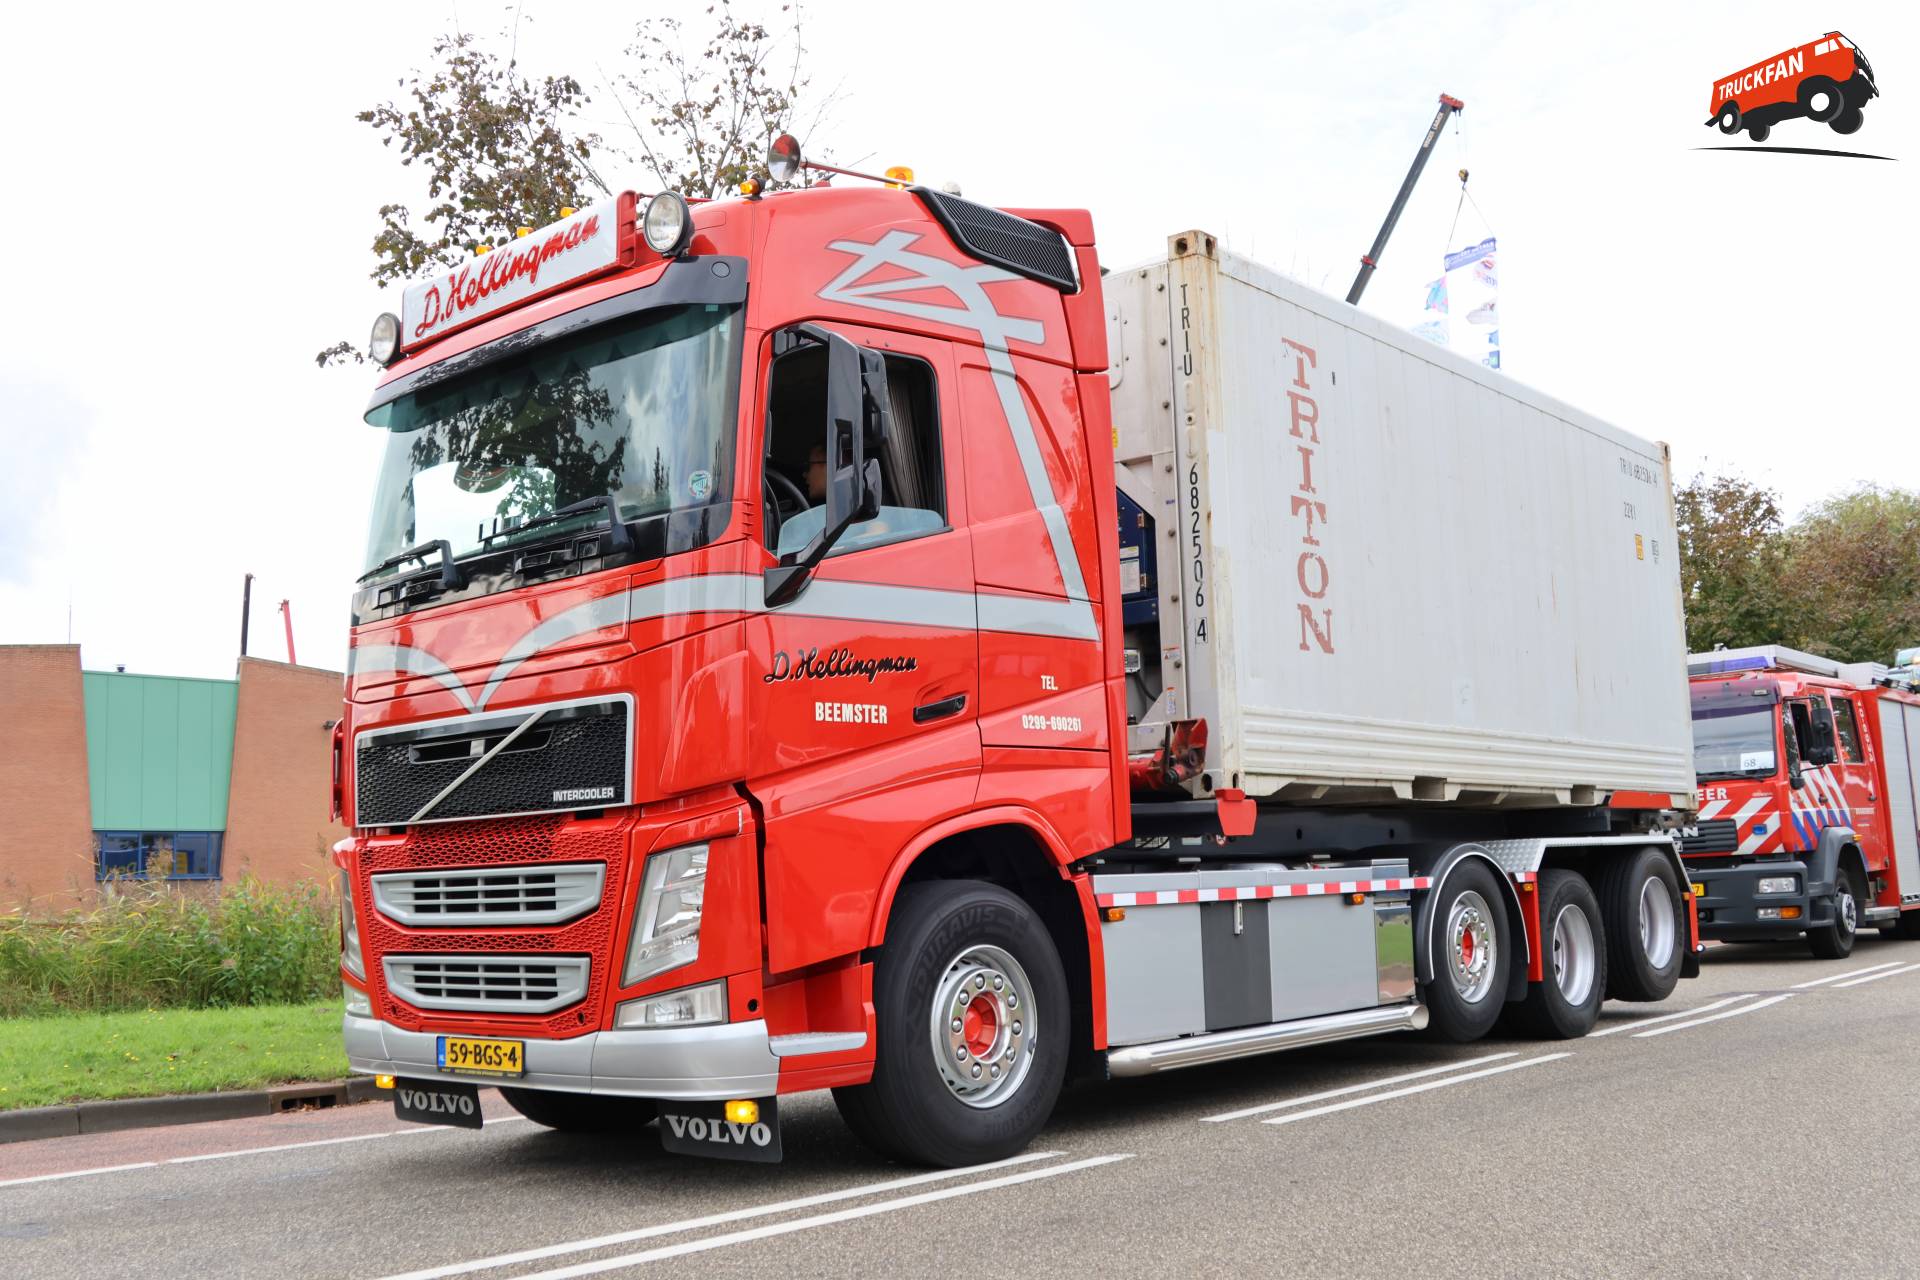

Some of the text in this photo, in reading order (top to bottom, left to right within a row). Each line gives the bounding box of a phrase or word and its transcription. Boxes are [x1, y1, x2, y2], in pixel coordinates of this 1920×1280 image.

[1180, 284, 1193, 376] TRIU
[1189, 462, 1204, 607] 682506
[1281, 337, 1335, 655] TRITON
[1041, 675, 1059, 691] TEL.
[815, 702, 888, 725] BEEMSTER
[1022, 714, 1082, 732] 0299-690261
[553, 786, 615, 802] INTERCOOLER
[1697, 788, 1728, 801] EER
[450, 1043, 517, 1067] 59-BGS-4
[400, 1089, 474, 1116] VOLVO
[664, 1115, 772, 1147] VOLVO
